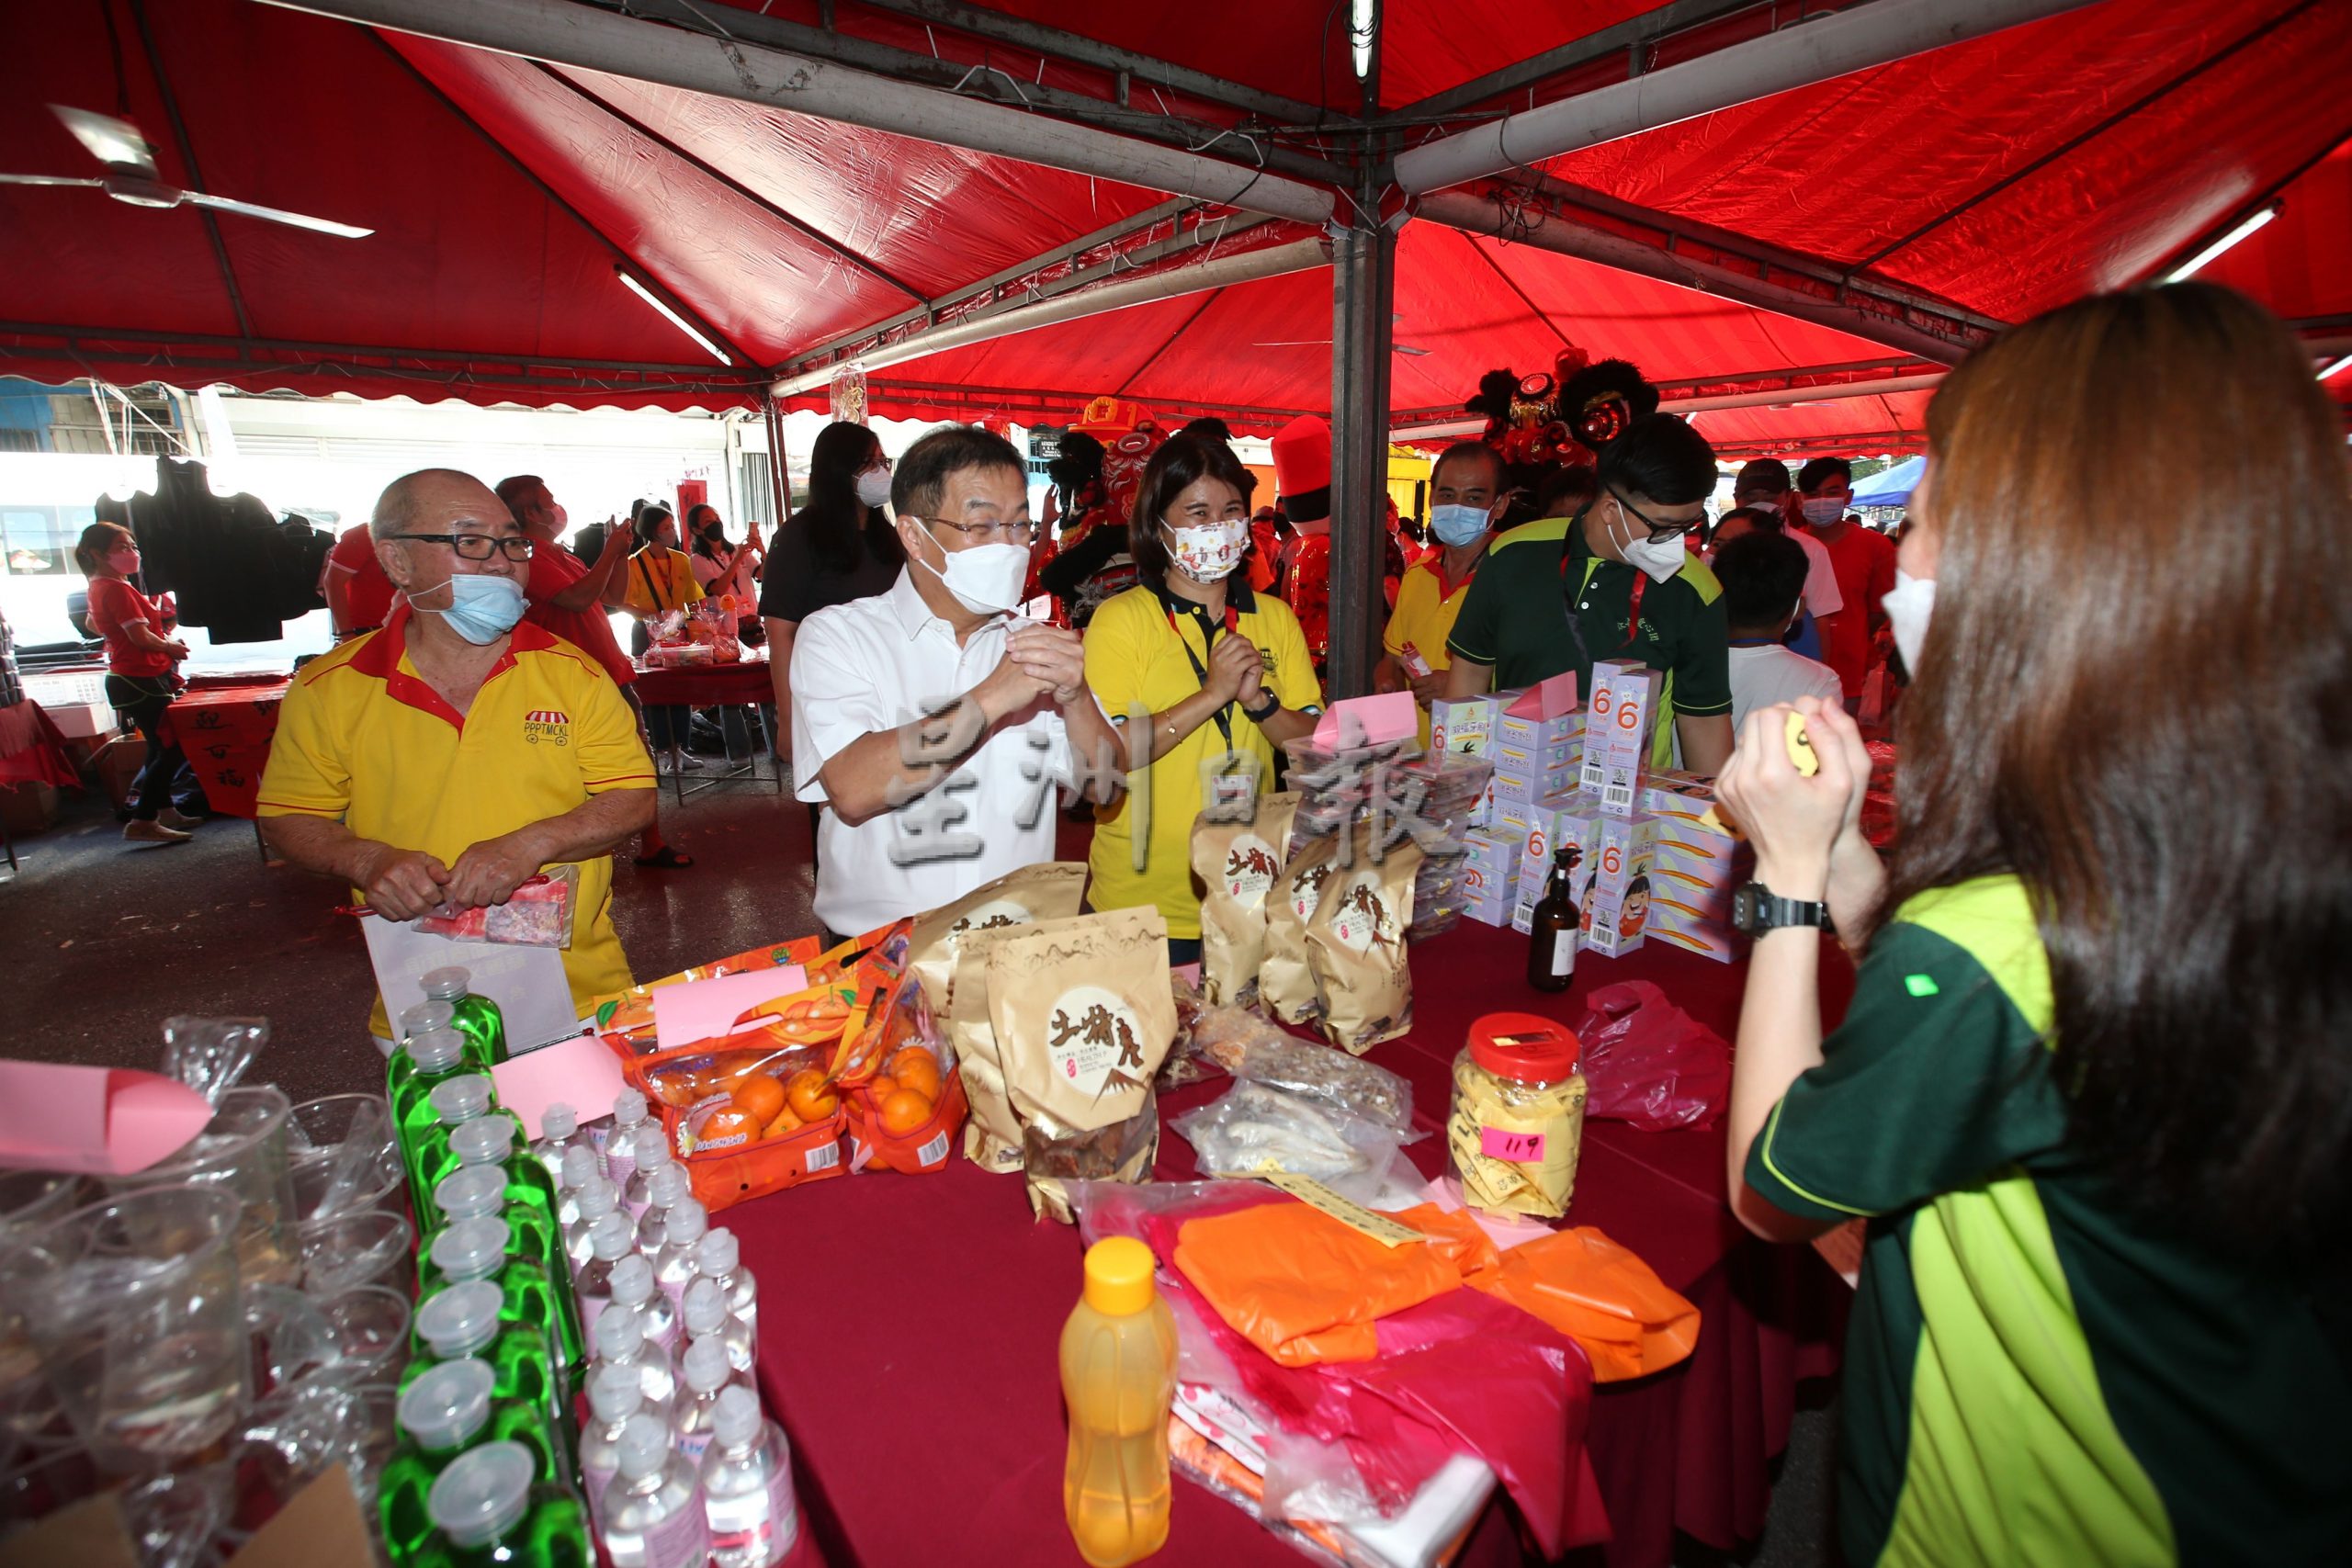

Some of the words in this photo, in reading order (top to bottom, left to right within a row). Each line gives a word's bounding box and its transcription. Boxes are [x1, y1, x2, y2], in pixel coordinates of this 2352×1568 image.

[1594, 689, 1611, 714] 6
[1617, 702, 1639, 729] 6
[524, 722, 570, 737] PPPTMCKL
[1434, 725, 1445, 749] 6
[1529, 830, 1546, 856] 6
[1603, 847, 1622, 874] 6
[1506, 1137, 1539, 1157] 119
